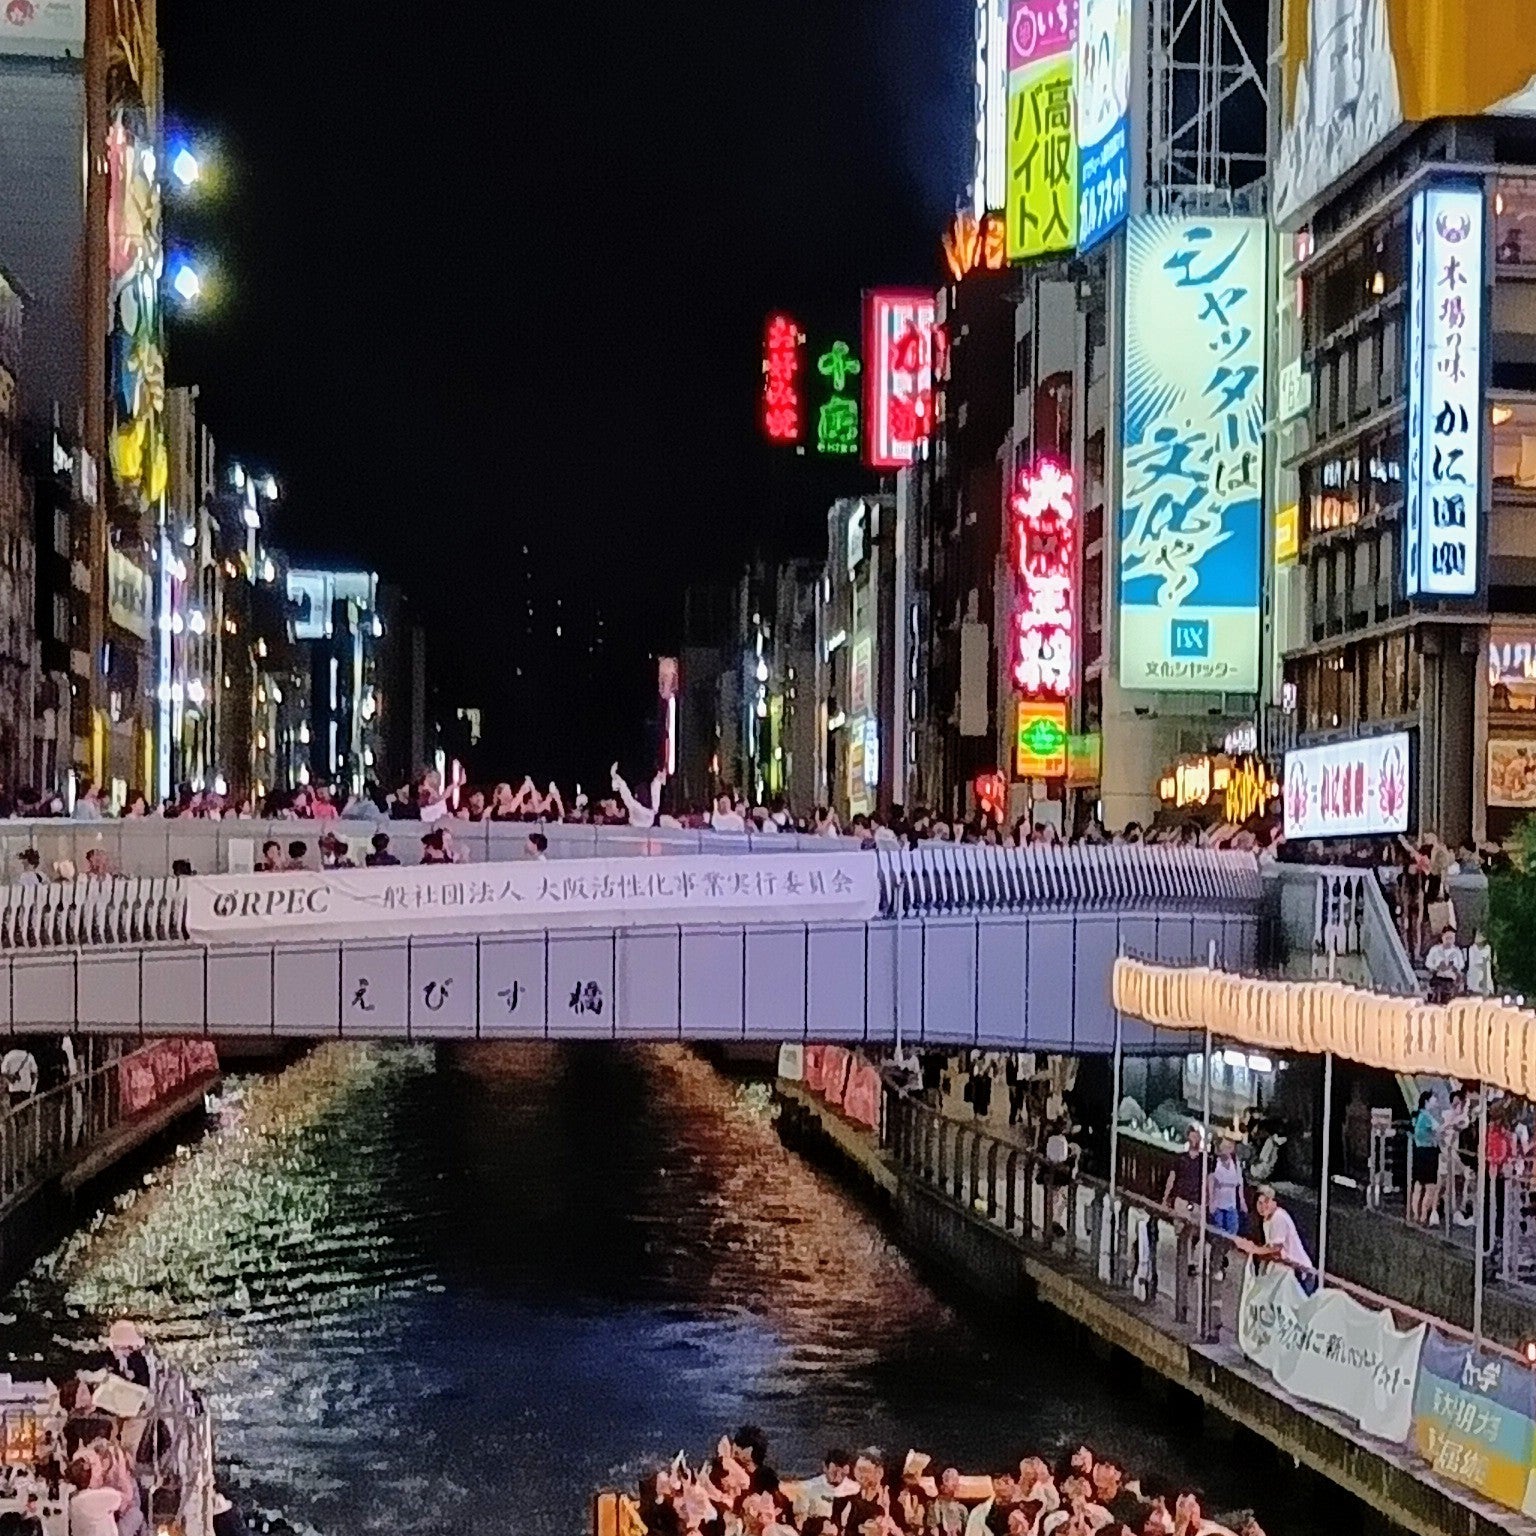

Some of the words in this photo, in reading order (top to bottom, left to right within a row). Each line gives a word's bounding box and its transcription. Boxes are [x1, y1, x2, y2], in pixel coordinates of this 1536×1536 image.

[1013, 83, 1043, 248] バイト
[1042, 78, 1072, 243] 高収入
[353, 880, 525, 910] 一般社団法人
